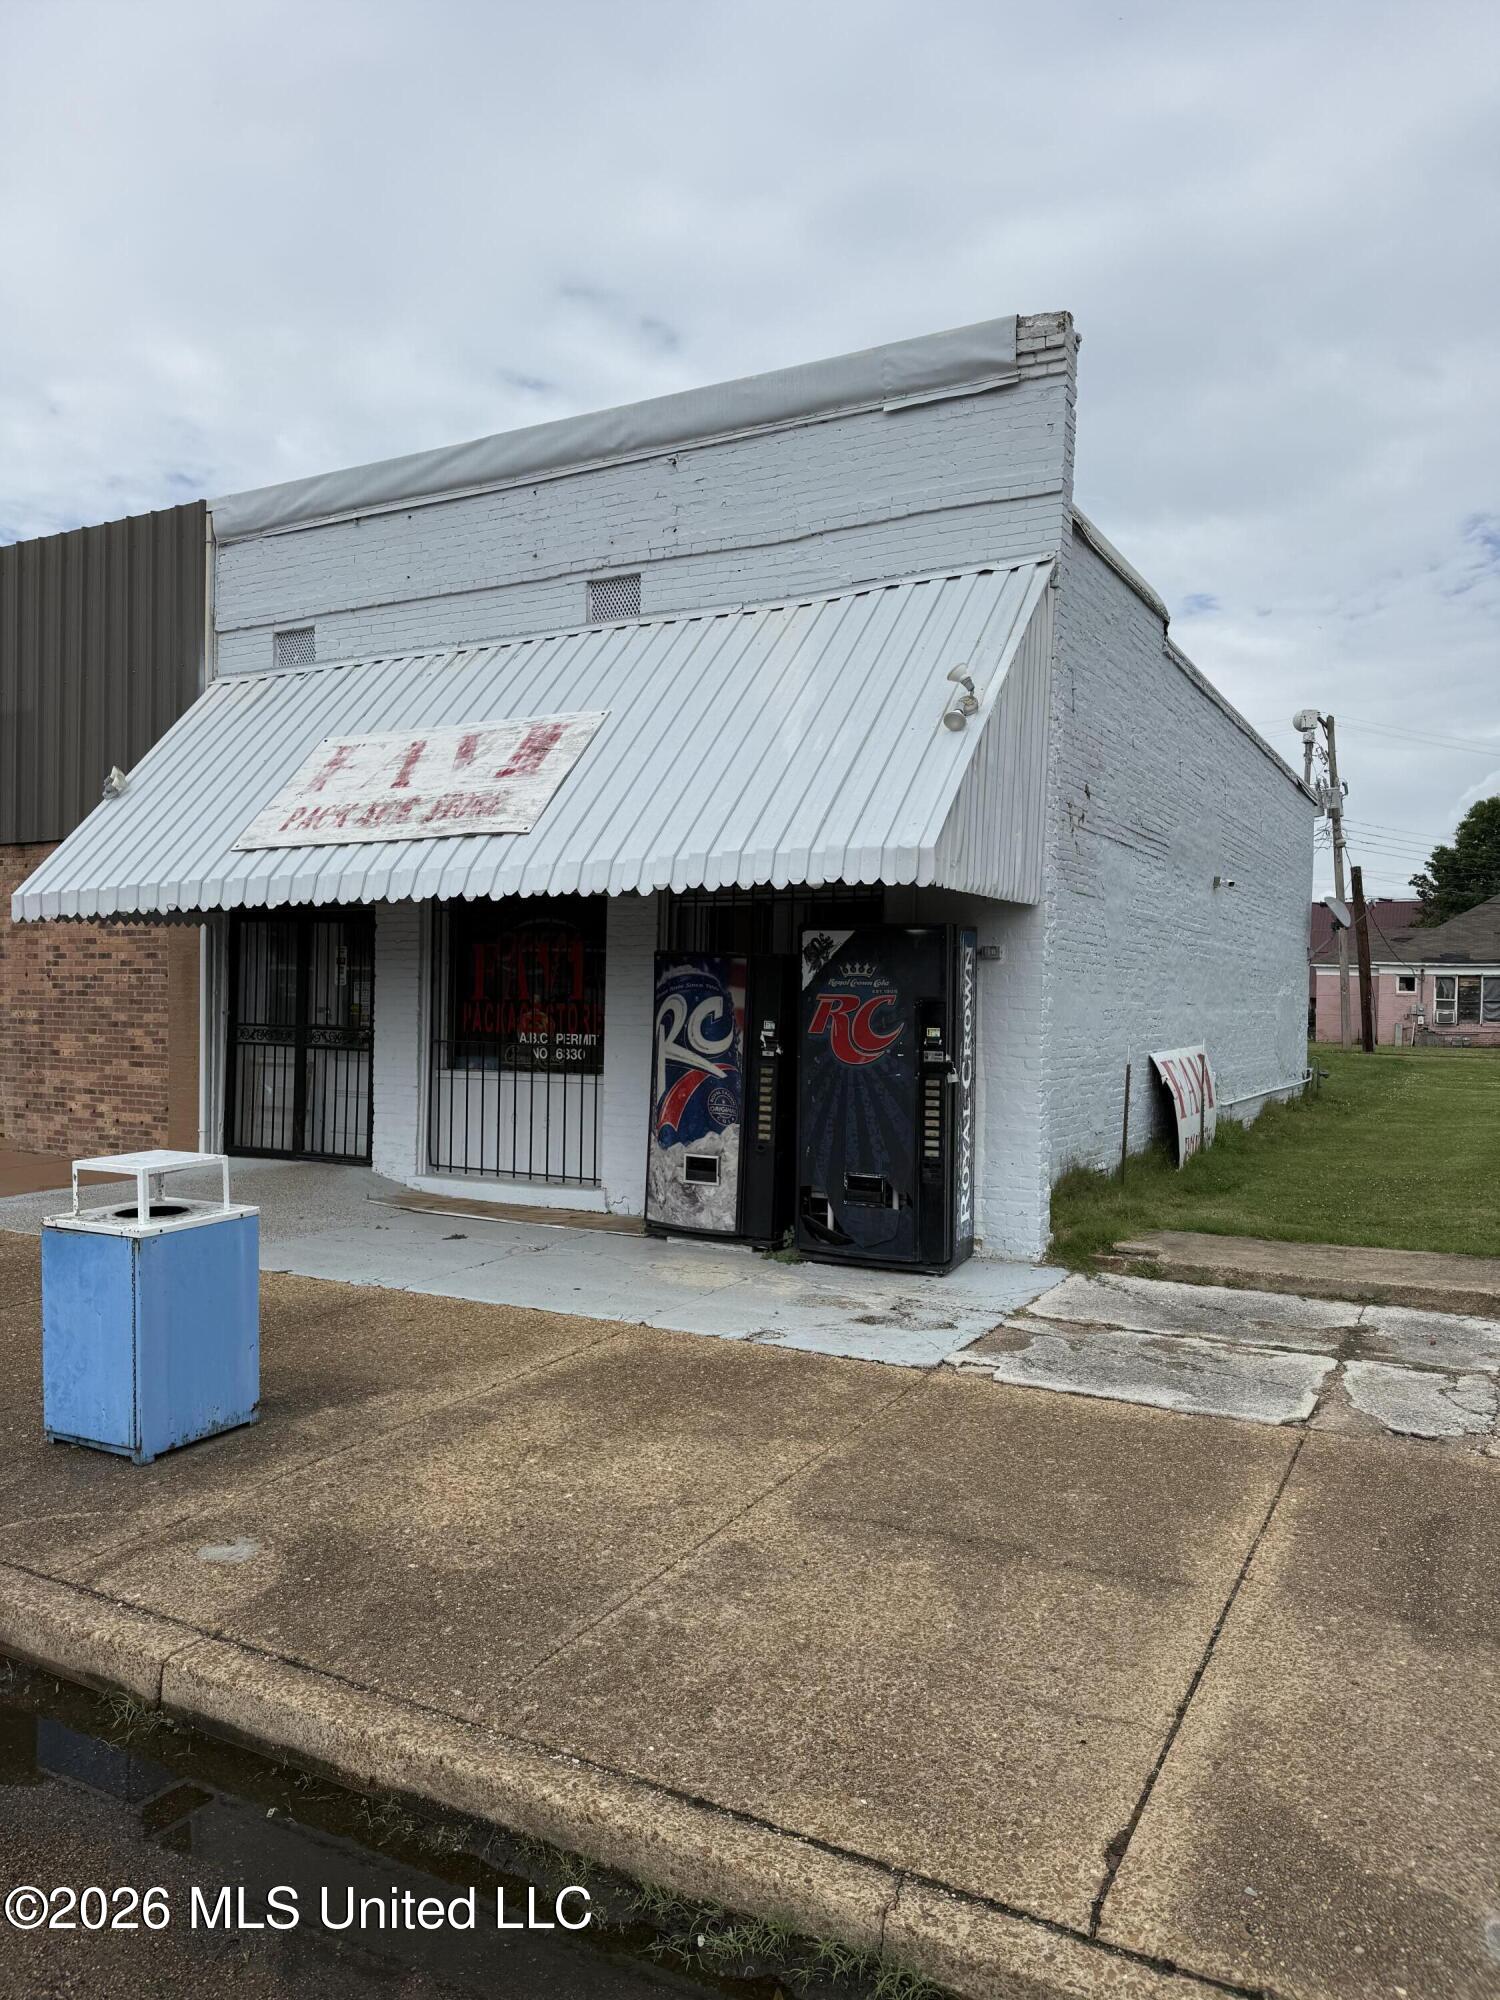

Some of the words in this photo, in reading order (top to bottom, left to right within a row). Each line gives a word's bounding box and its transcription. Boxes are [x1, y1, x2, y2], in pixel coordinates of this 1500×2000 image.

[556, 1033, 600, 1046] PERMIT
[656, 993, 734, 1106] RC
[808, 994, 904, 1065] RC
[962, 946, 973, 1090] CROWN
[960, 1097, 971, 1223] ROYAL
